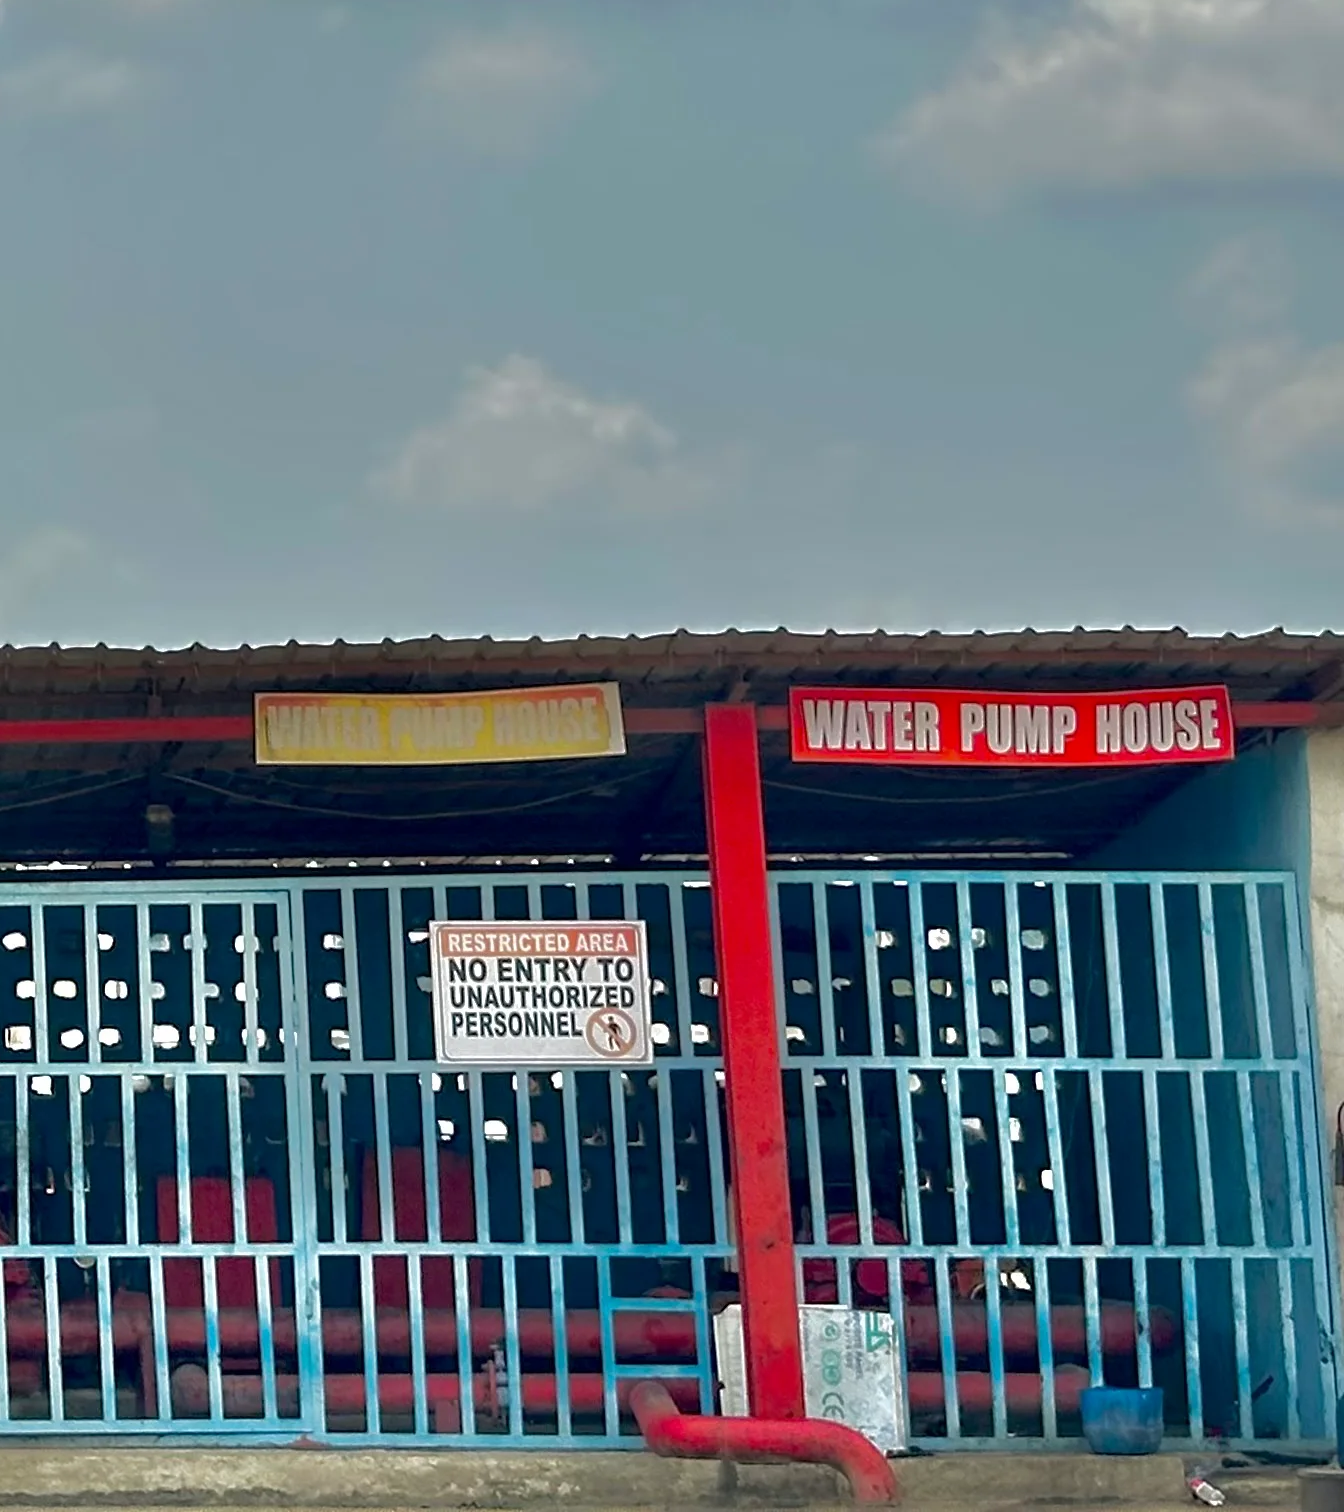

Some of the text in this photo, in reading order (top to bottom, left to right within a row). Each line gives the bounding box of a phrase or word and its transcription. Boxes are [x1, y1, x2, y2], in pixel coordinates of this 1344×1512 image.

[494, 696, 600, 746] HOUSE
[802, 699, 1221, 754] WATER PUMP HOUSE
[448, 932, 629, 953] RESTRICTED AREA
[448, 957, 634, 983] NO ENTRY TO
[449, 985, 636, 1009] UNAUTHORIZED
[451, 1011, 584, 1037] PERSONNEL
